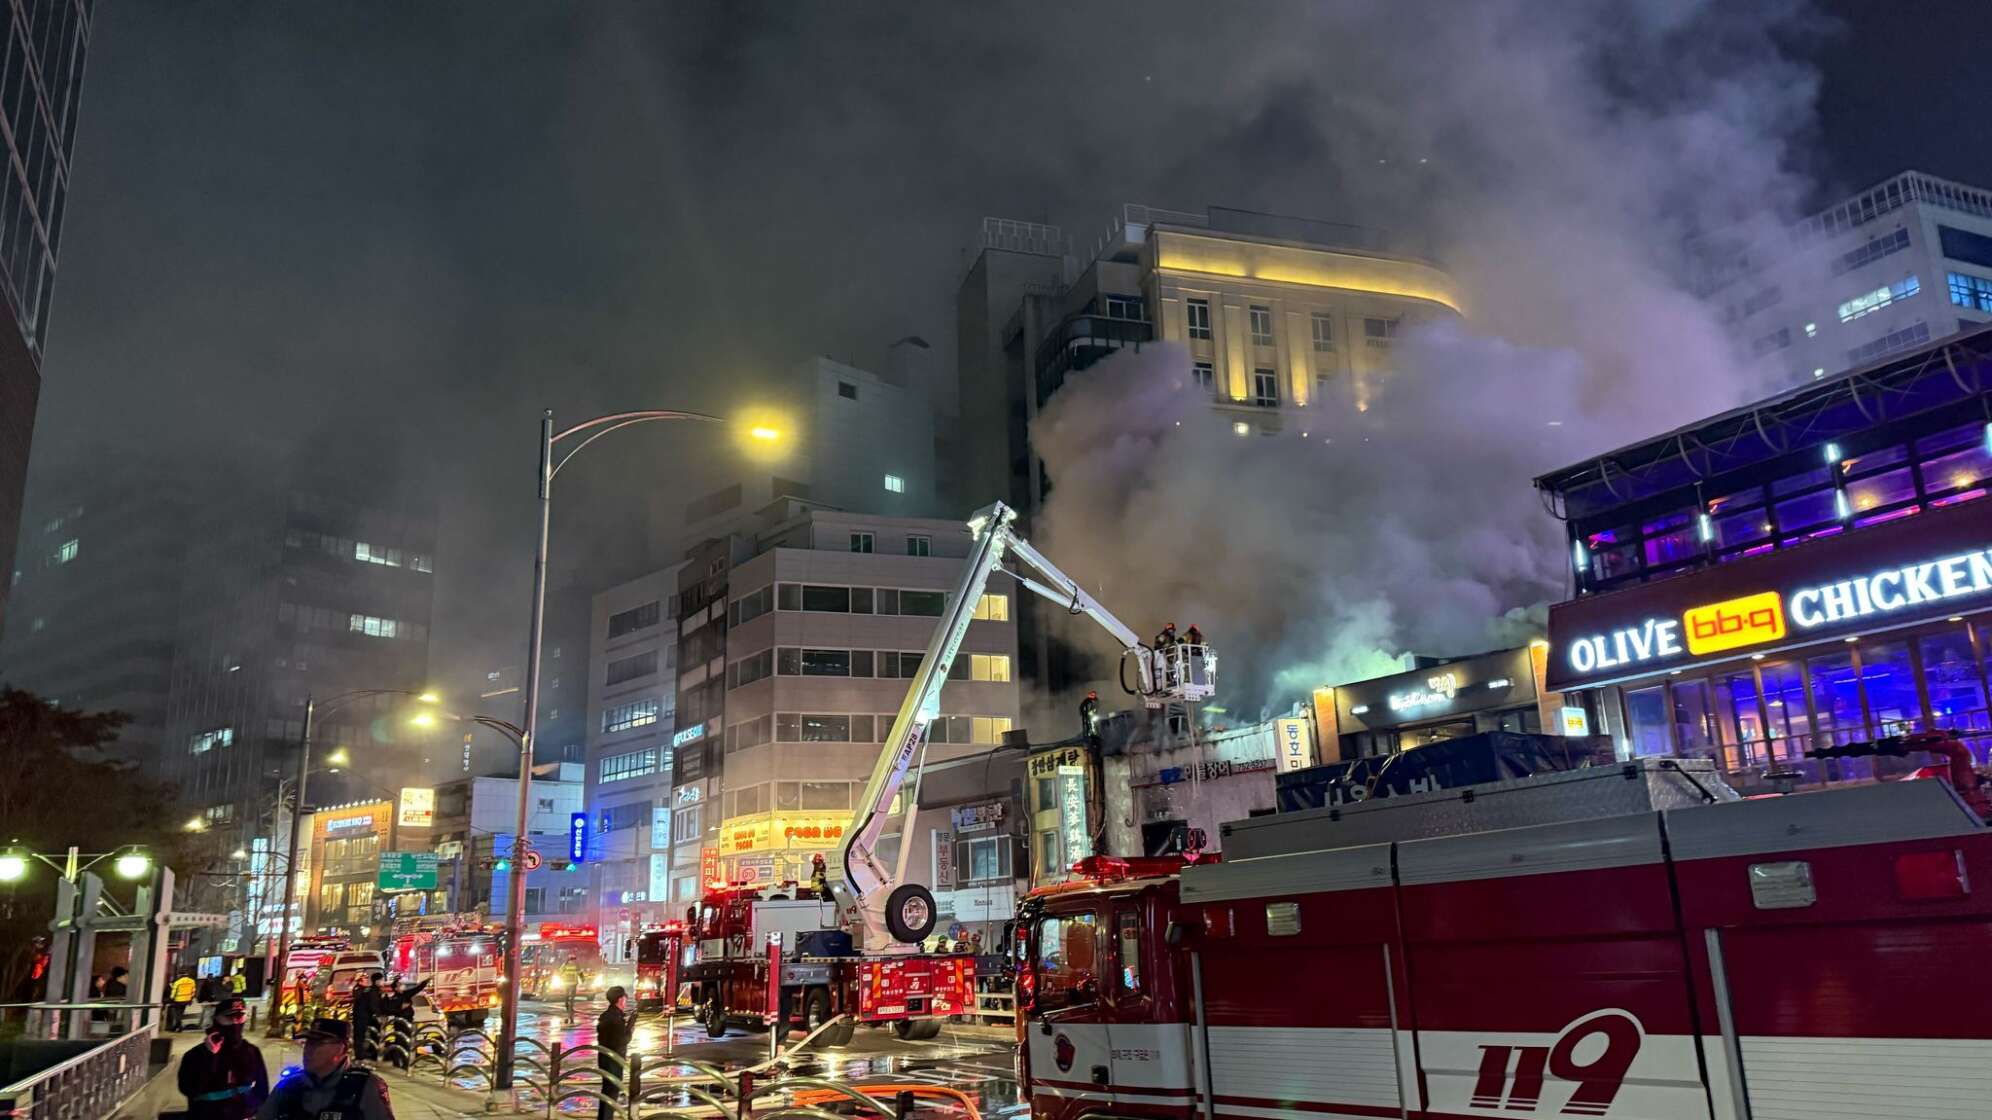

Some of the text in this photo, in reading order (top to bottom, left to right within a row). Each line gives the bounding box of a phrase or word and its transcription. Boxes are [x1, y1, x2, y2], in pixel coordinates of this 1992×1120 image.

[1570, 618, 1683, 672] OLIVE
[1790, 548, 1992, 627] CHICKEN
[1469, 1013, 1642, 1116] 119
